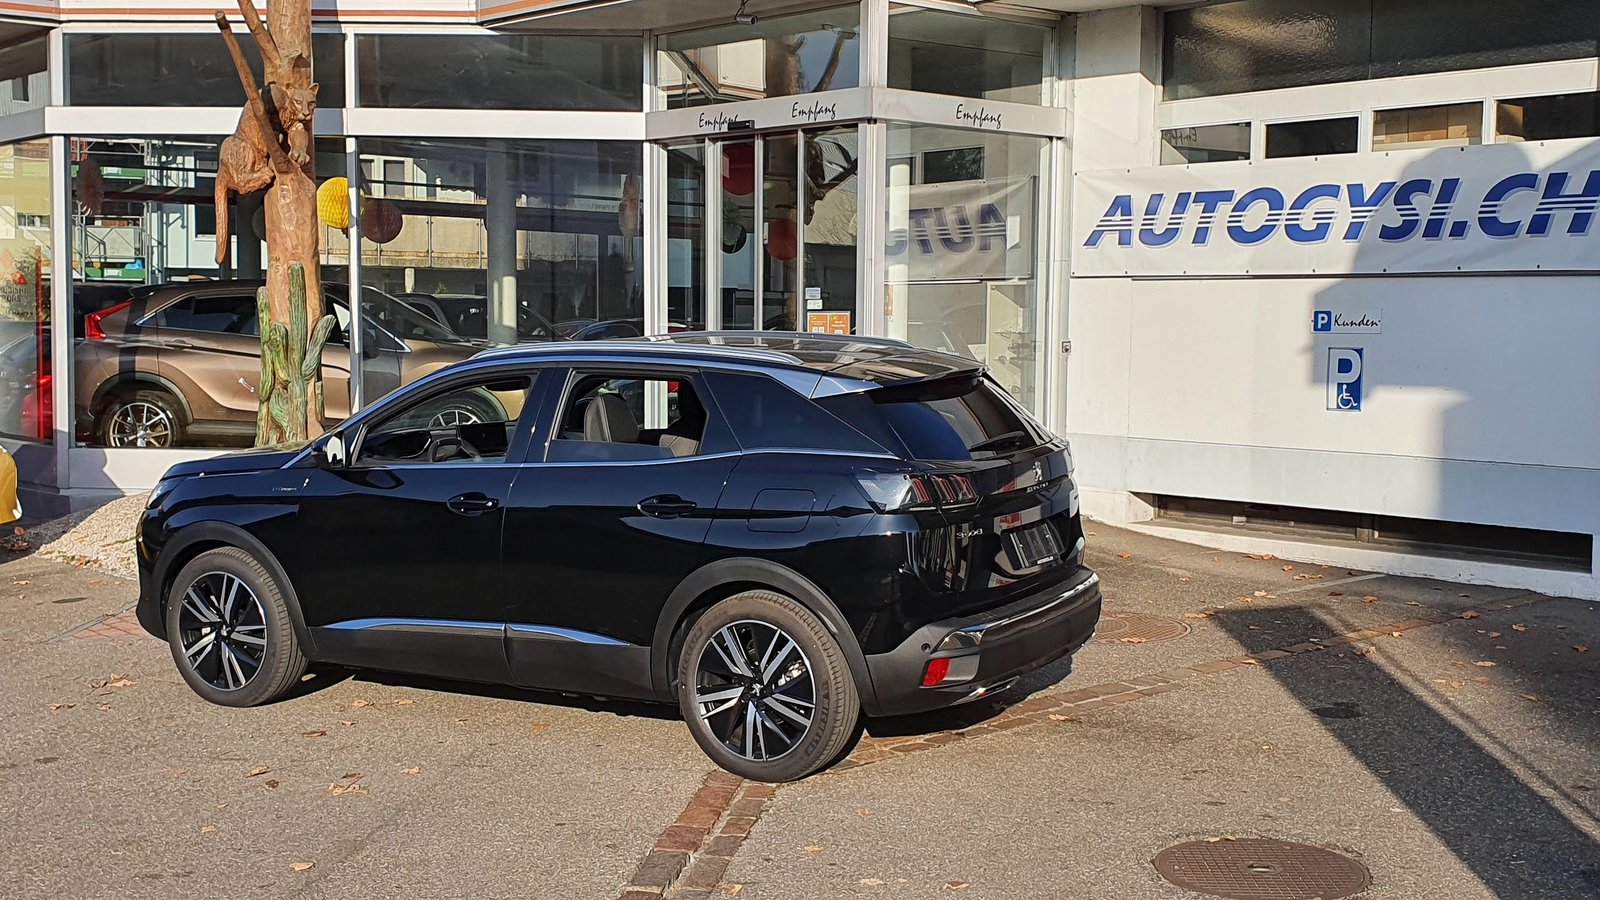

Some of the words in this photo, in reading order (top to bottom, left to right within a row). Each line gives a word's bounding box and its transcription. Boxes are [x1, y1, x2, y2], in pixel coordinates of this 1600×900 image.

[791, 100, 837, 121] Empfang
[955, 103, 1003, 129] Empfang
[1082, 170, 1600, 248] AUTOGYSI.CH
[1317, 313, 1329, 329] P
[1333, 313, 1379, 327] Kunden
[1328, 348, 1361, 409] P
